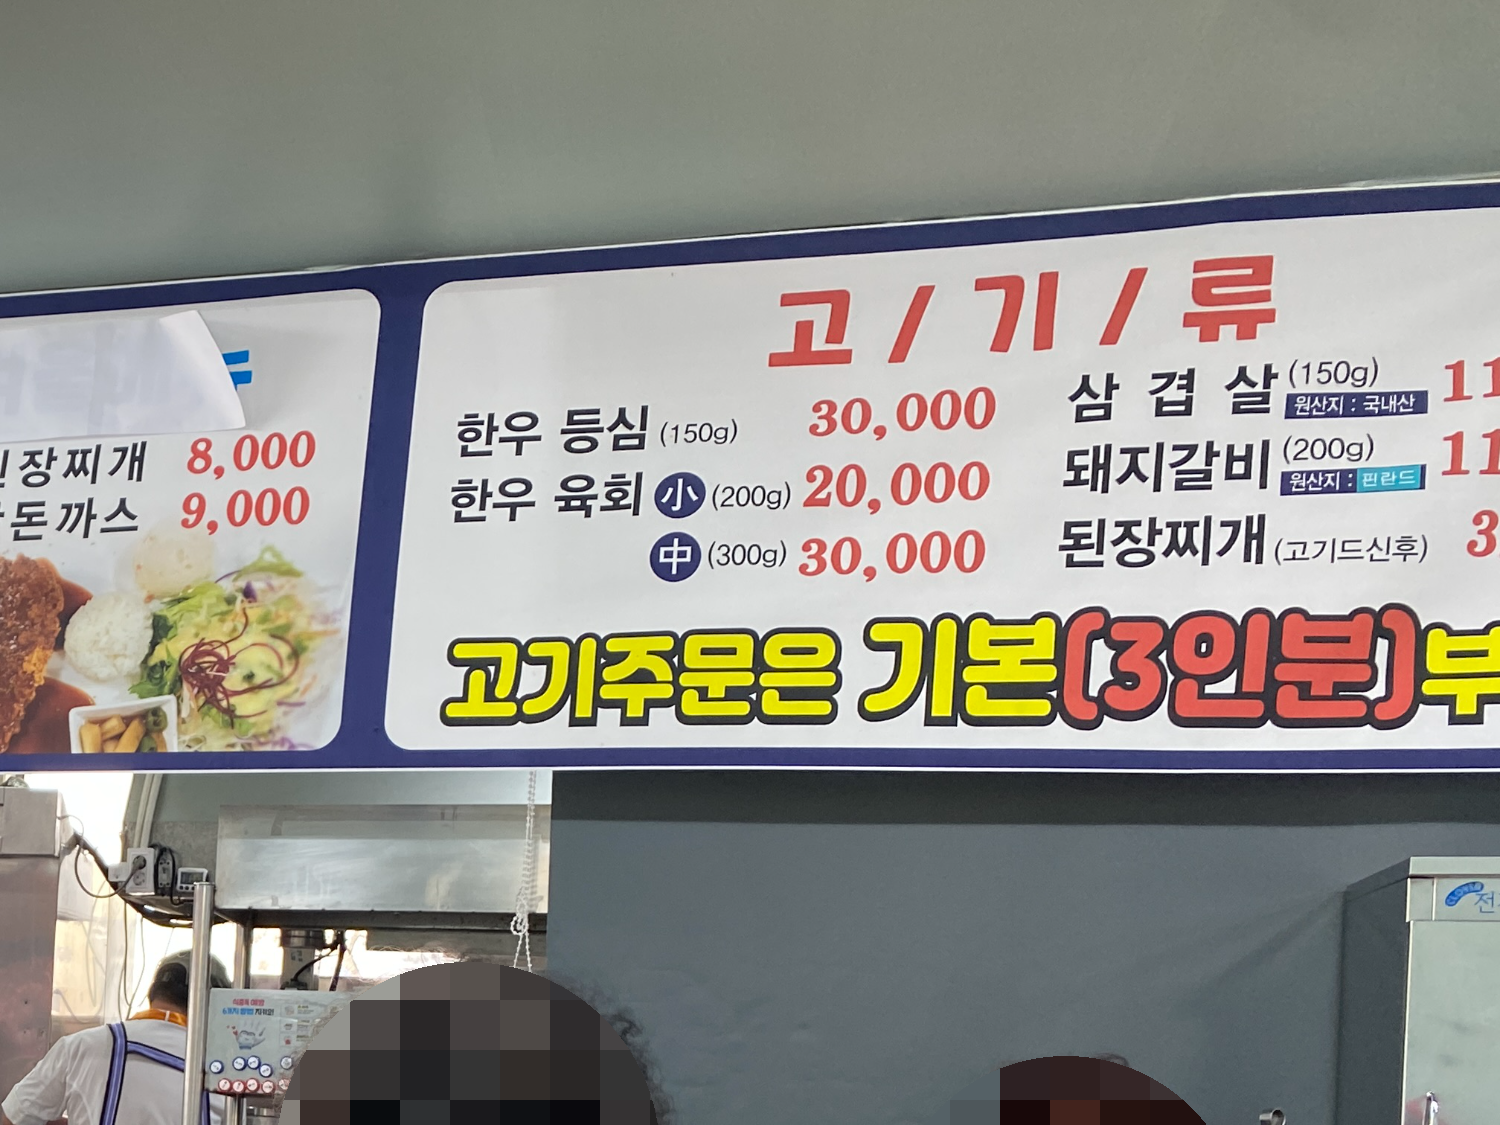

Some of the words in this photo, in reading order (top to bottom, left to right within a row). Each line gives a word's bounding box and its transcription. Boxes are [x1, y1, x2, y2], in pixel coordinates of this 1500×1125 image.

[1289, 357, 1379, 388] (150g)
[457, 411, 541, 459] 한우
[559, 405, 649, 454] 등심
[659, 419, 739, 448] (150g)
[809, 386, 997, 440] 30,000
[1294, 394, 1344, 416] 원산지
[1363, 394, 1415, 414] 국내산
[186, 430, 316, 480] 8,000
[1062, 438, 1270, 494] 돼지갈비
[1283, 433, 1374, 464] (200g)
[1289, 472, 1340, 493] 원산지
[1362, 470, 1416, 488] 핀란드
[180, 486, 310, 536] 9,000
[451, 476, 536, 523] 한우
[554, 472, 643, 518] 육회
[658, 476, 701, 515] 小
[712, 481, 792, 511] (200g)
[802, 460, 990, 515] 20,000
[656, 537, 695, 578] 中
[707, 540, 787, 570] (300g)
[798, 529, 986, 582] 30,000
[1058, 513, 1266, 568] 된장찌개
[1274, 533, 1429, 564] (고기드신후)
[444, 631, 840, 721] 고기주문은
